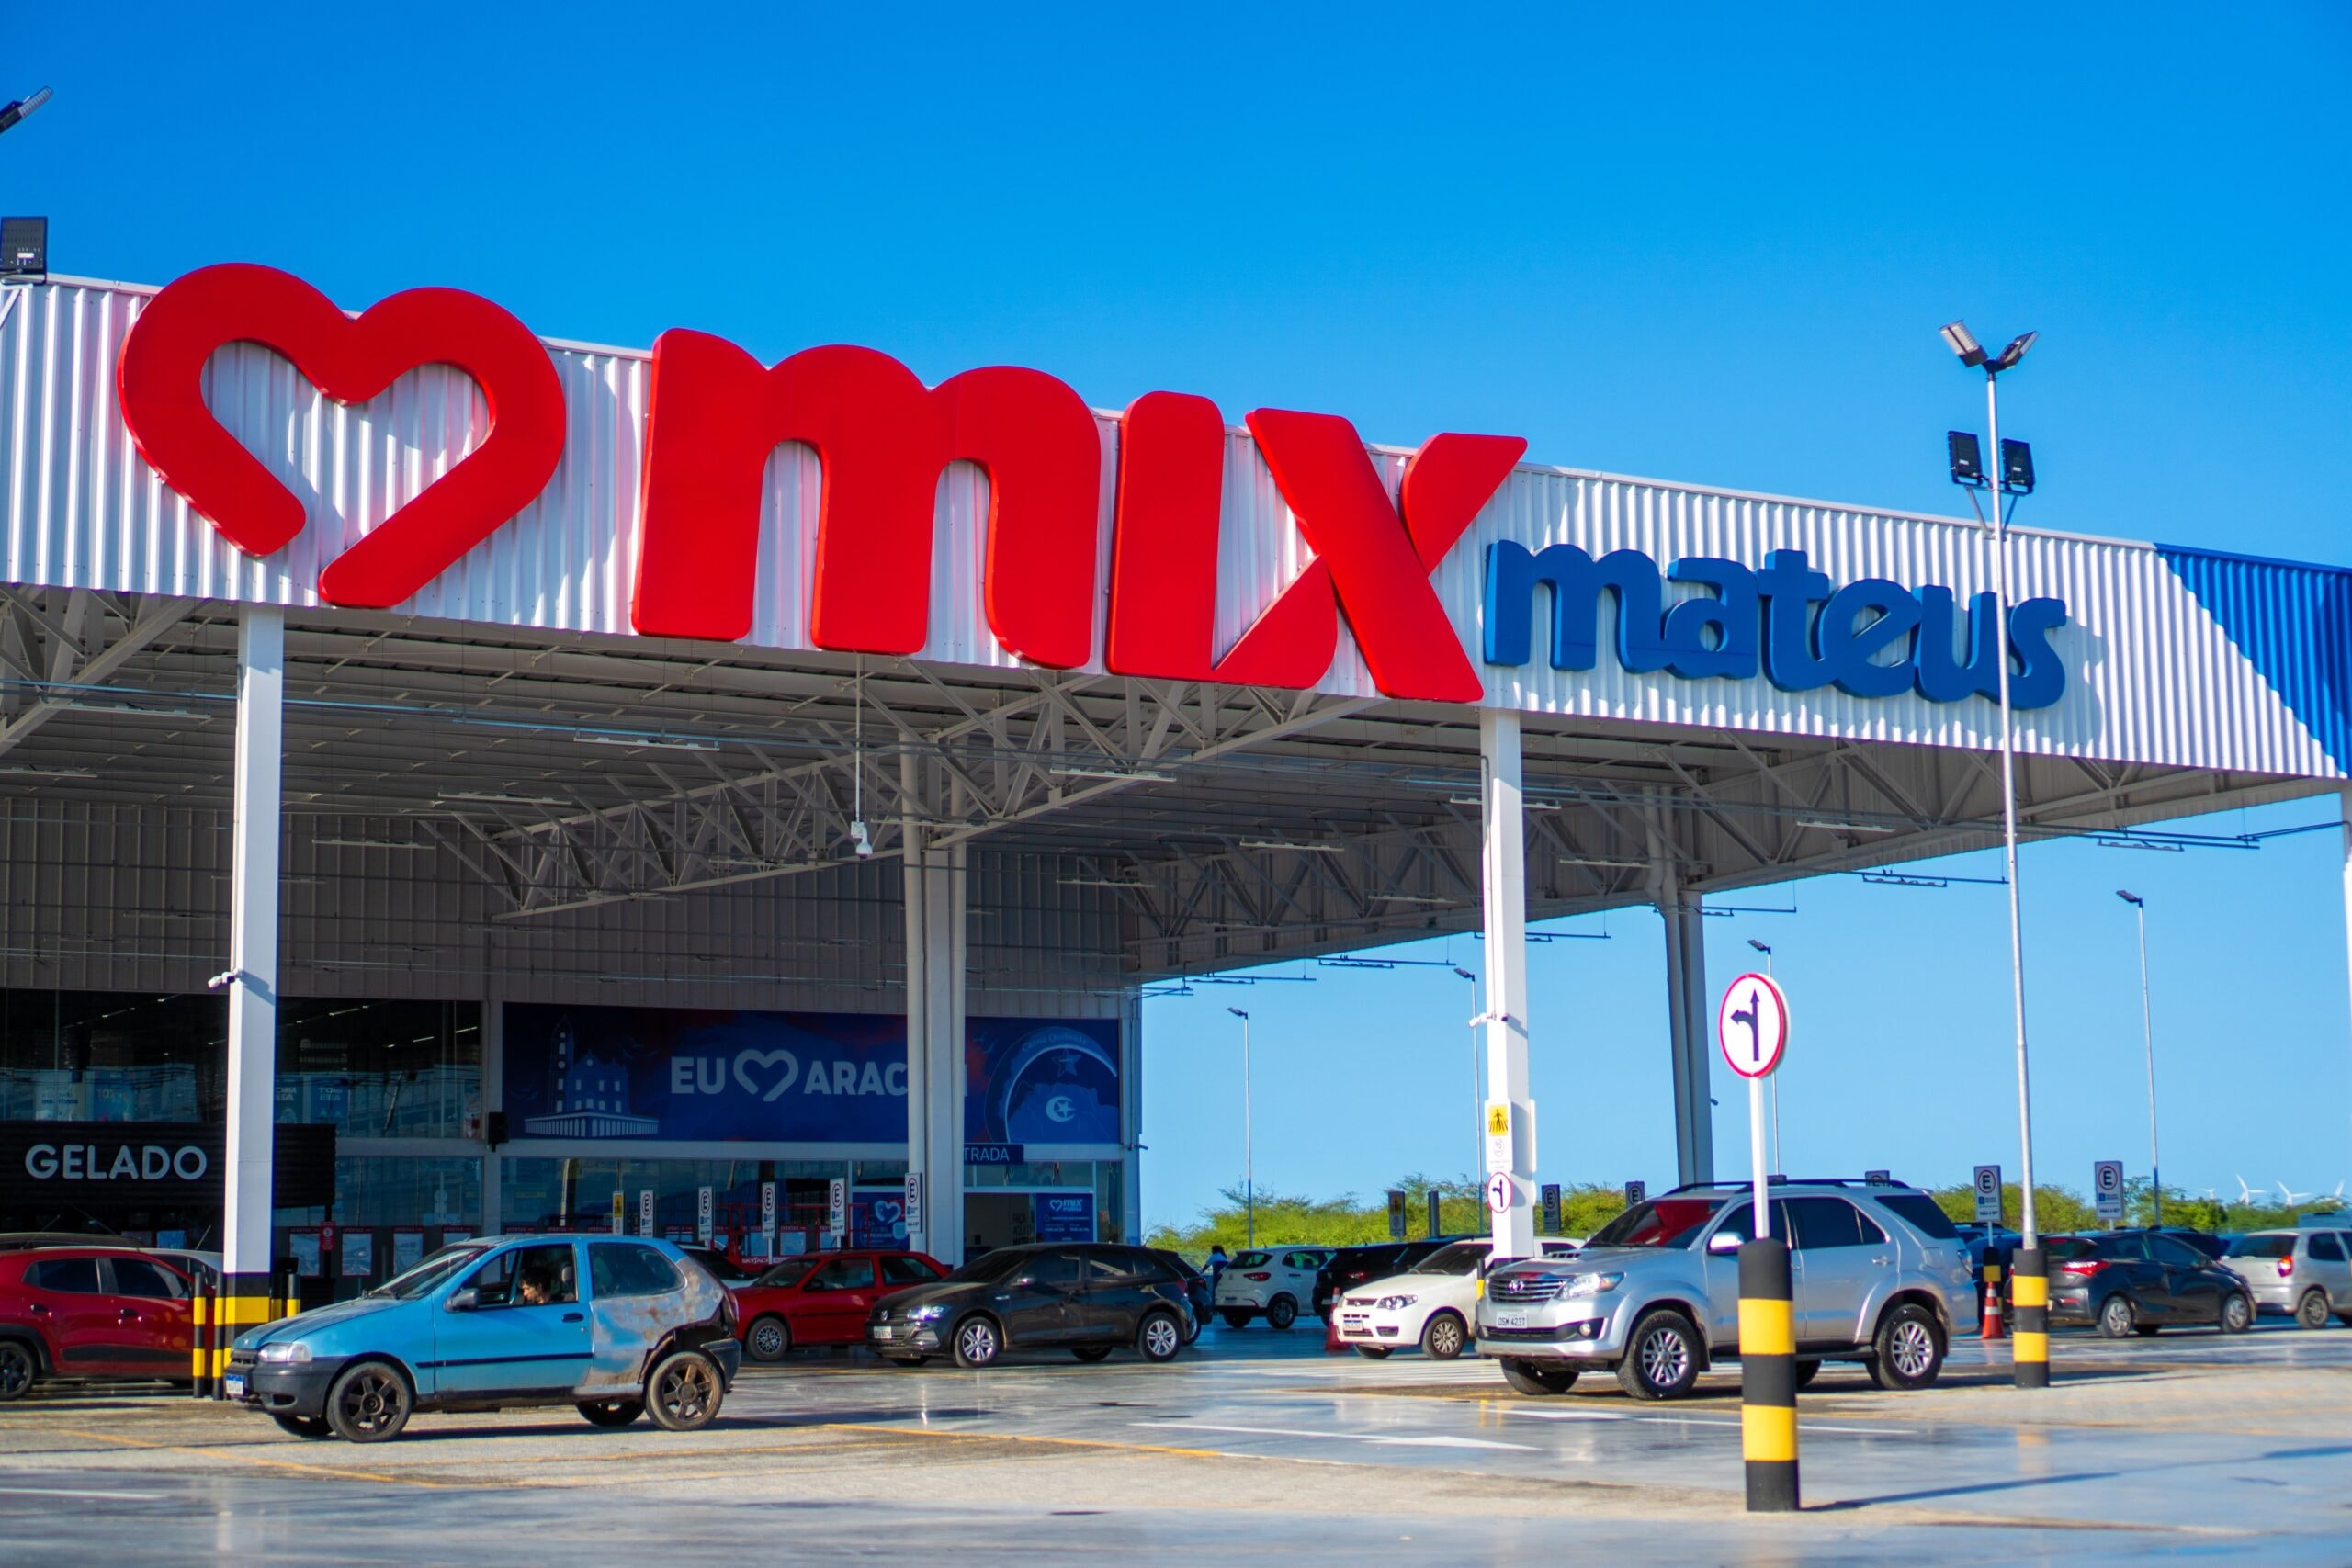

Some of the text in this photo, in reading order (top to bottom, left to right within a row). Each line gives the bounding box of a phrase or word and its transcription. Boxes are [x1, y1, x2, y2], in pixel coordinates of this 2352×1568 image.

[630, 327, 1527, 702] mix
[1484, 538, 2067, 710] mateus
[671, 1057, 967, 1098] EU ARAC
[25, 1144, 208, 1180] GELADO
[964, 1147, 1010, 1162] TRADA
